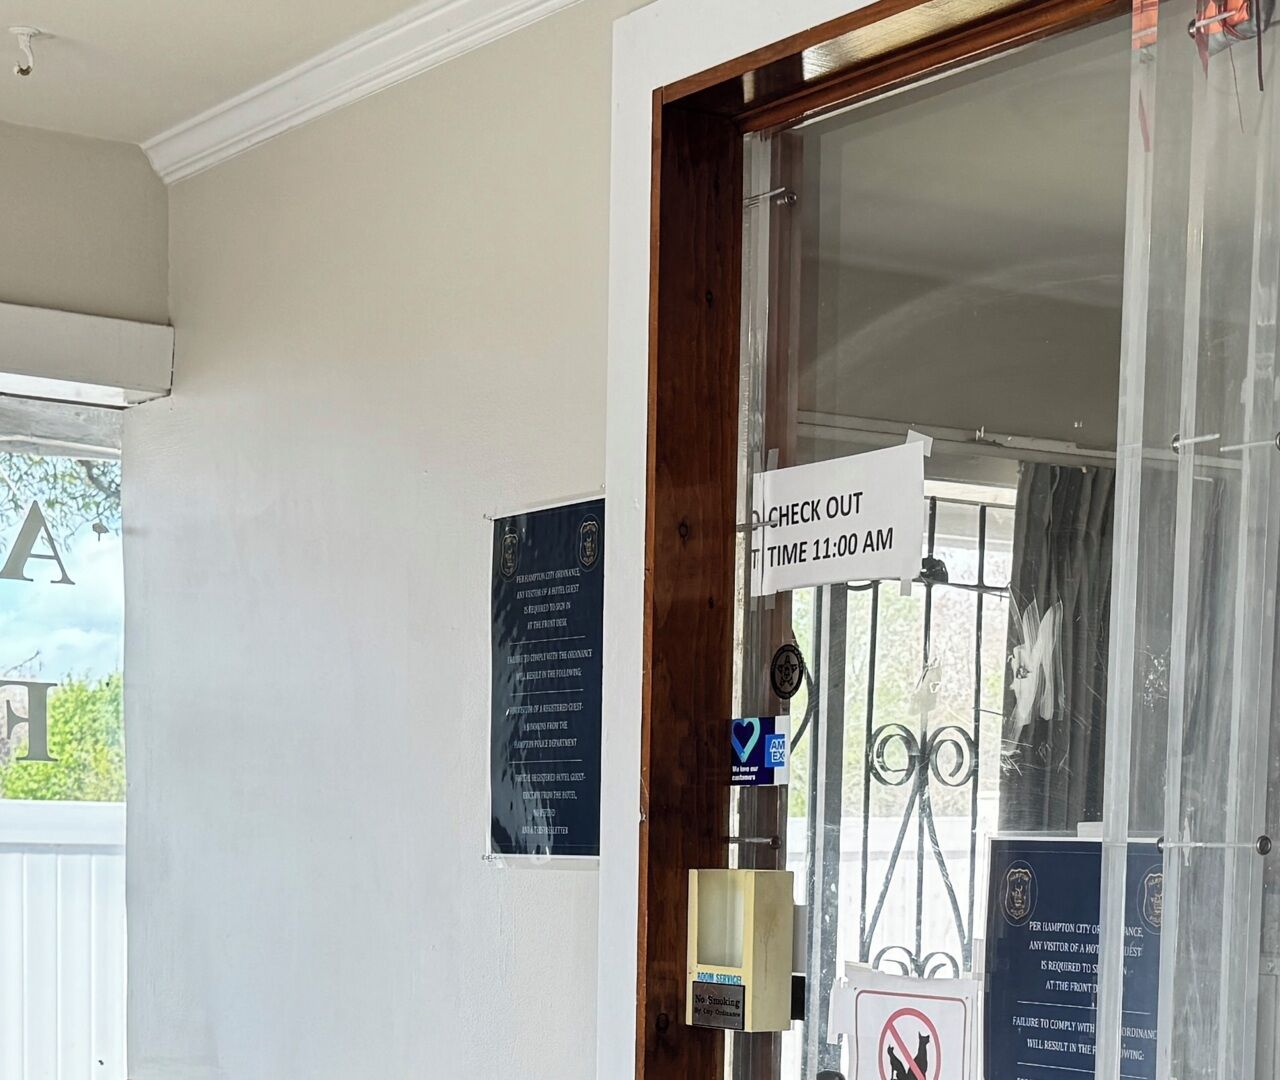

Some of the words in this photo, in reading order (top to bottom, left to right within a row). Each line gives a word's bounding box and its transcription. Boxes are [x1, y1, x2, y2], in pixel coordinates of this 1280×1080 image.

[768, 497, 822, 529] CHECK
[825, 491, 864, 519] OUT
[767, 541, 808, 568] TIME
[812, 532, 858, 562] 11:00
[862, 526, 894, 553] AM
[1029, 921, 1042, 932] PER
[1042, 922, 1075, 934] HAMPTON
[1075, 923, 1091, 935] CITY
[1029, 940, 1043, 951] ANY
[1043, 941, 1069, 952] VISITOR
[1069, 942, 1079, 953] OF
[1040, 960, 1047, 970] IS
[1047, 961, 1081, 973] REQUIRED
[1082, 963, 1092, 973] TO
[1045, 980, 1055, 991] AT
[1055, 981, 1069, 991] THE
[1069, 981, 1093, 993] FRONT
[708, 996, 741, 1009] Smoking
[1012, 1016, 1040, 1028] FAILURE
[1040, 1018, 1050, 1028] TO
[1050, 1019, 1076, 1031] COMPLY
[1076, 1021, 1095, 1033] WITH
[1122, 1028, 1158, 1040] ORDINANC
[1027, 1038, 1043, 1050] WILL
[1044, 1039, 1068, 1052] RESULT
[1069, 1042, 1077, 1052] IN
[1078, 1043, 1092, 1054] THE
